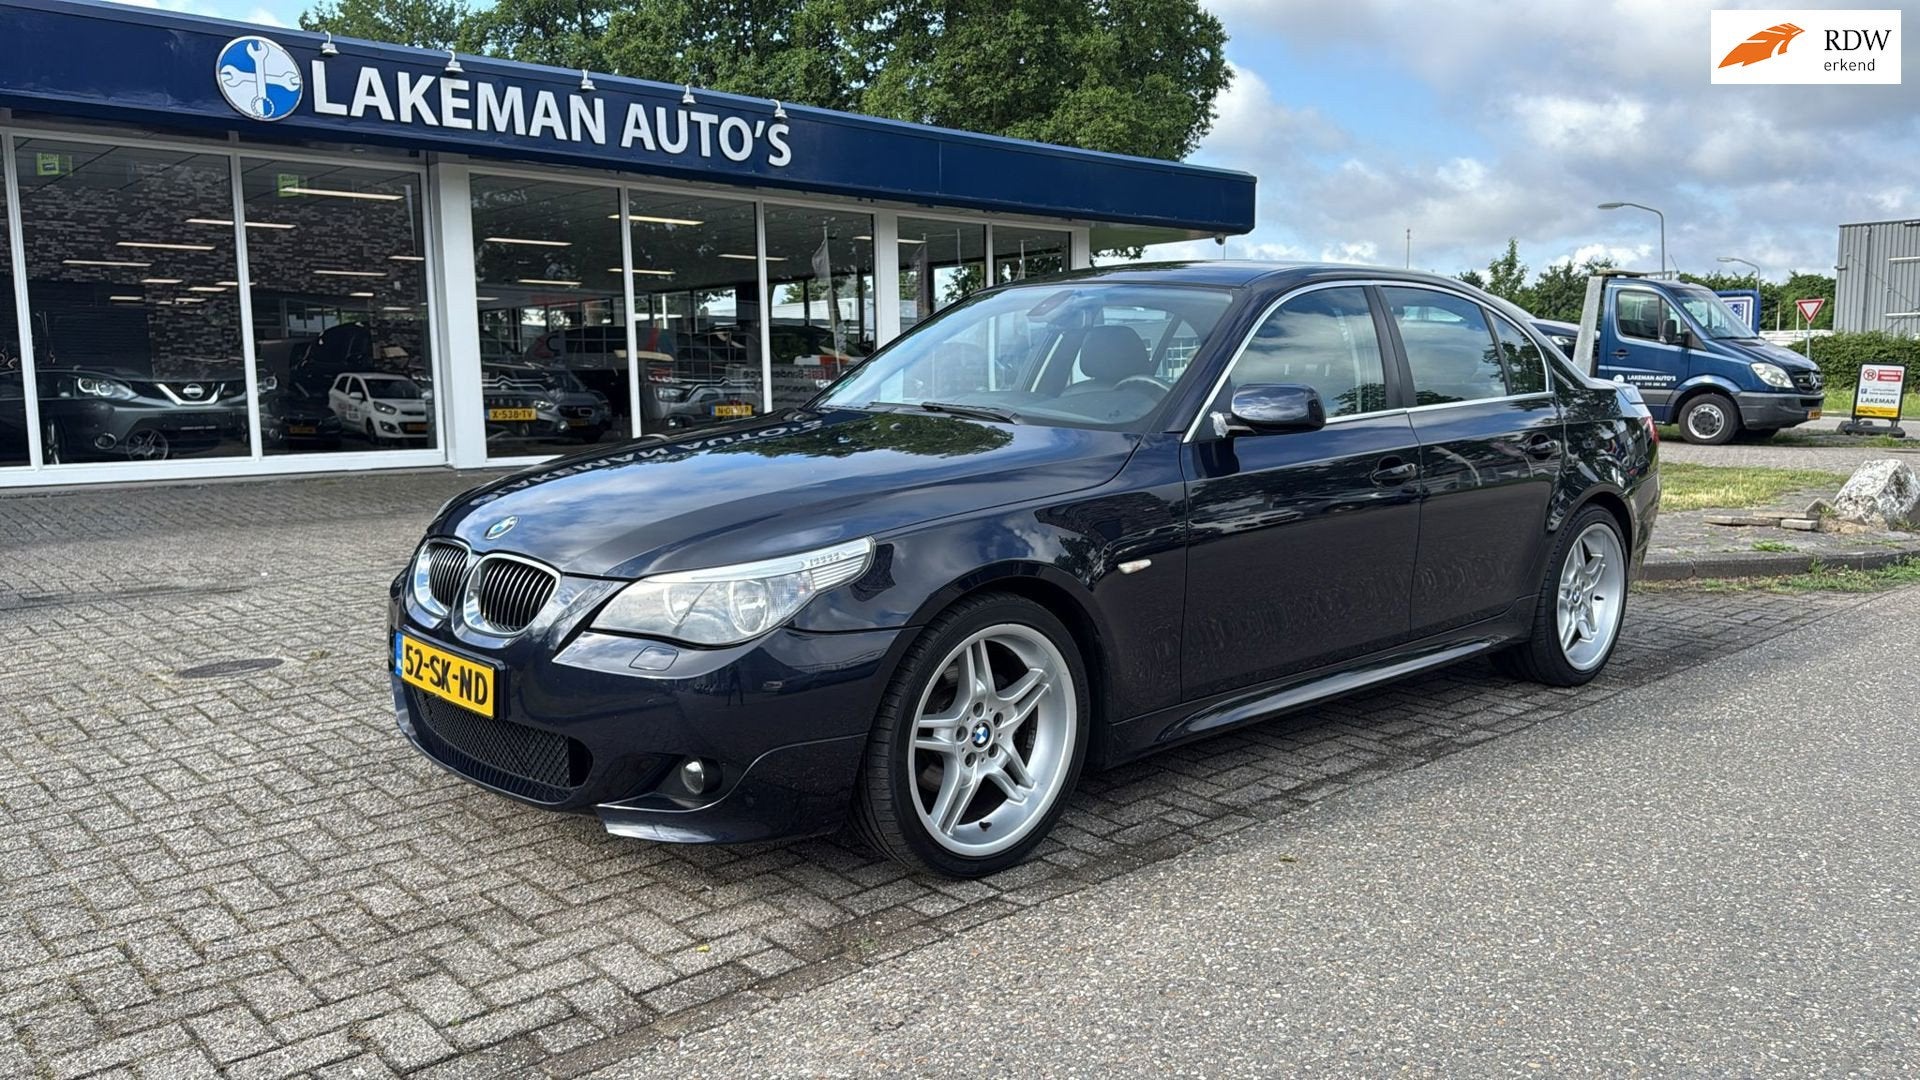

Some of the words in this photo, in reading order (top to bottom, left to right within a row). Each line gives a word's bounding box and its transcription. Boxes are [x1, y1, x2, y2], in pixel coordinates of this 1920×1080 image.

[310, 60, 606, 145] LAKEMAN
[620, 102, 793, 168] AUTO'S
[491, 410, 533, 419] X-538-TV
[405, 643, 489, 706] 52-SK-ND
